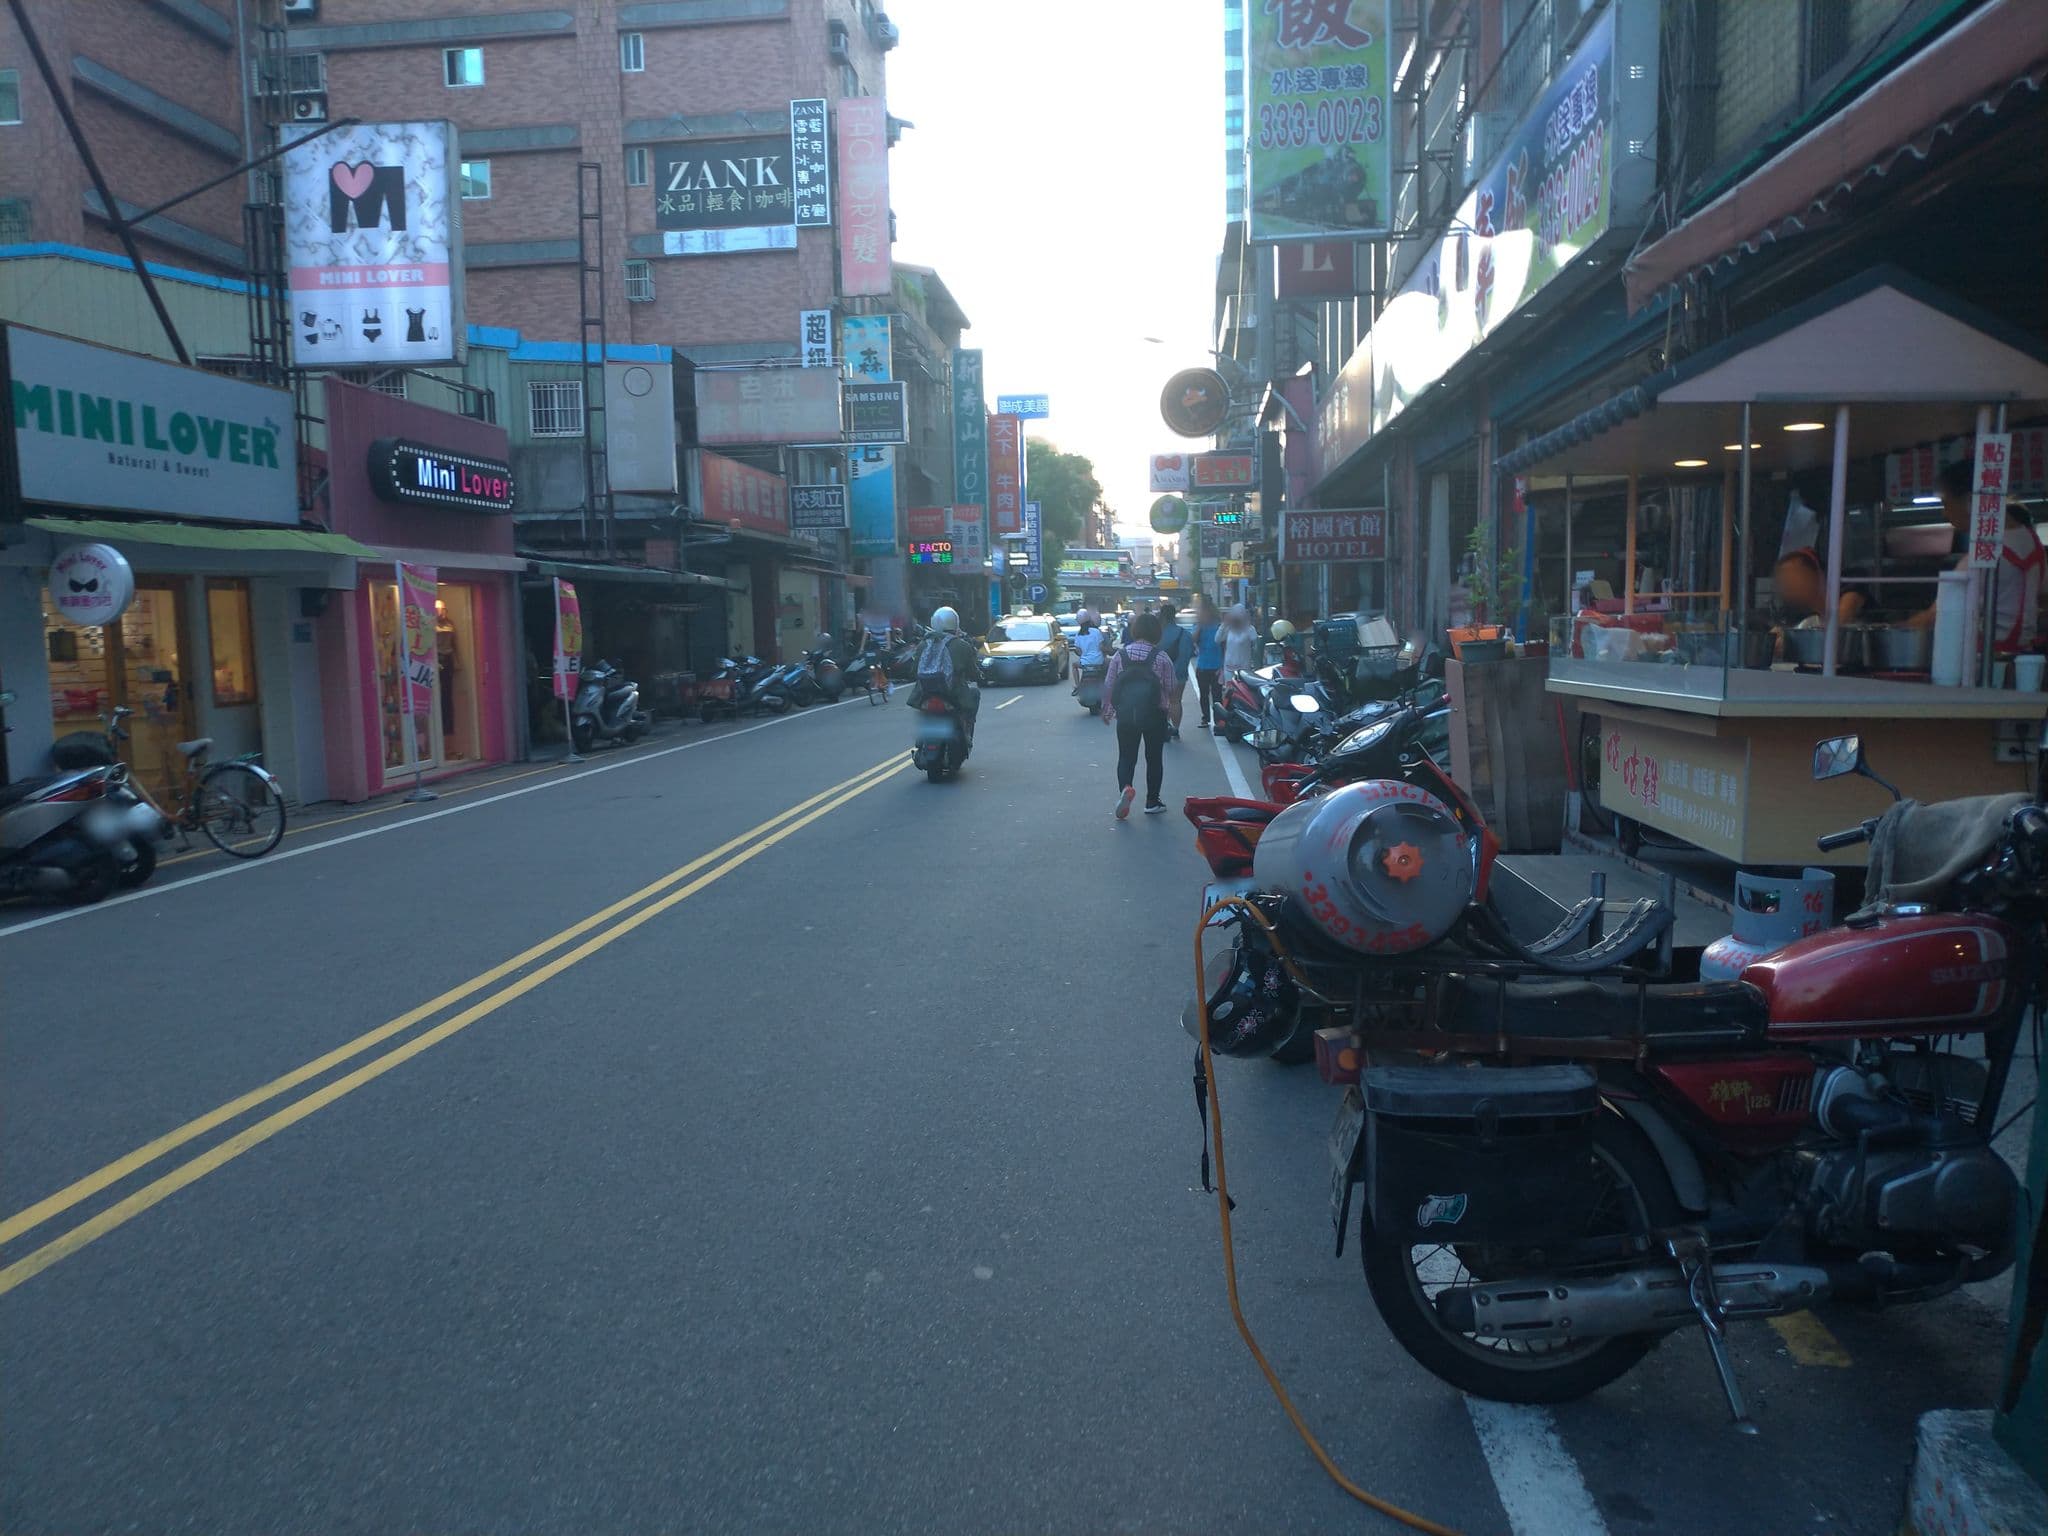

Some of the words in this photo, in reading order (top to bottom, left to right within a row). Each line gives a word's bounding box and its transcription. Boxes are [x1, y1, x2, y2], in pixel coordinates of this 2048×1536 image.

[1271, 64, 1369, 95] 外送專線
[794, 105, 824, 115] ZANK
[1259, 96, 1382, 149] 333-0023
[667, 155, 784, 192] ZANK
[656, 193, 696, 216] 冰品
[706, 191, 745, 214] 輕食
[754, 187, 795, 210] 咖啡
[319, 271, 361, 285] MINI
[366, 269, 424, 283] LOVER
[844, 391, 900, 402] SAMSUNG
[11, 380, 135, 446] MINI
[141, 404, 280, 470] LOVER
[107, 452, 157, 471] Natural
[162, 462, 171, 473] &
[176, 462, 210, 478] Sweet
[416, 457, 456, 491] Mini
[460, 466, 510, 500] Lover
[1974, 442, 2006, 562] 點餐請排隊
[1289, 514, 1381, 539] 裕國賓館
[1296, 541, 1375, 557] HOTEL
[1031, 586, 1044, 600] P
[1606, 729, 1661, 808] 咕咕雞
